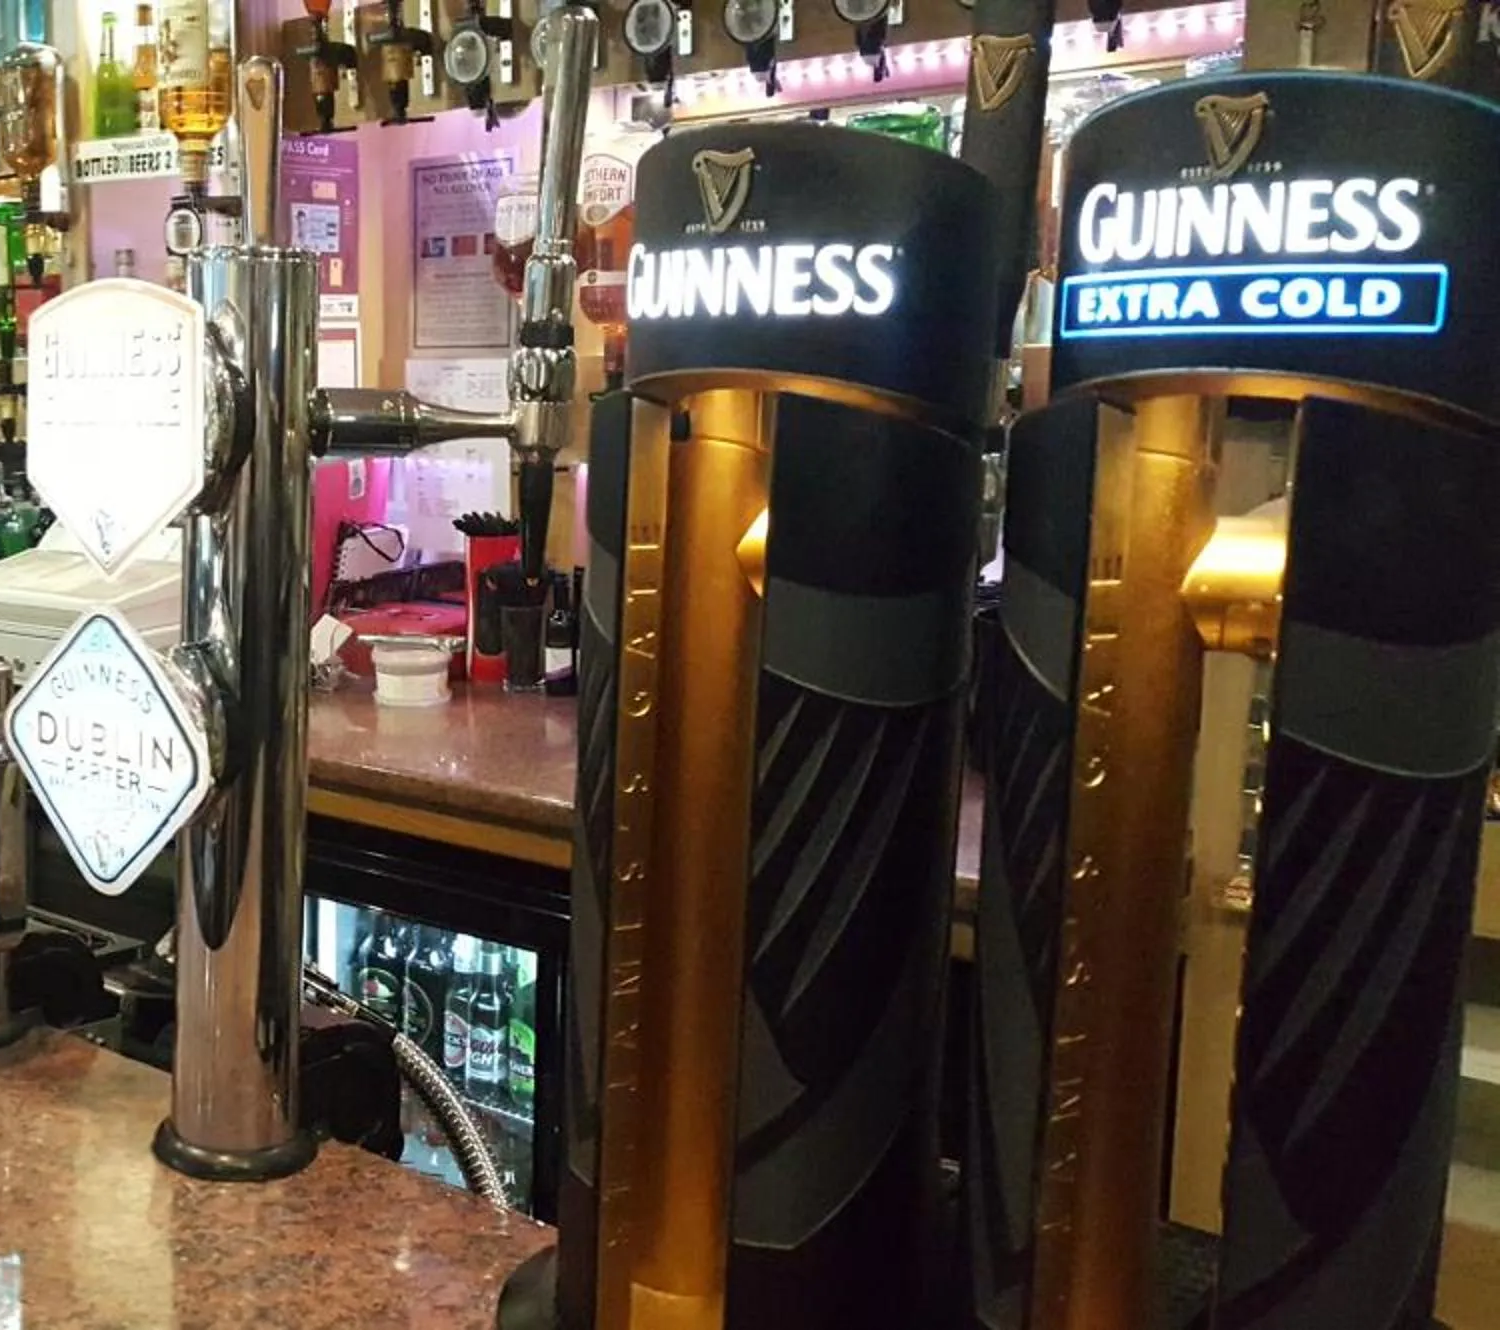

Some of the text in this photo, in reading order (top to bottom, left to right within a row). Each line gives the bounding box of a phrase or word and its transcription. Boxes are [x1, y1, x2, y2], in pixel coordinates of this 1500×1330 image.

[1078, 178, 1422, 263] GUINNESS
[627, 242, 896, 320] GUINNESS
[1077, 277, 1401, 324] EXTRA COLD
[51, 663, 156, 715] GUINNESS
[37, 710, 174, 773] DUBLIN
